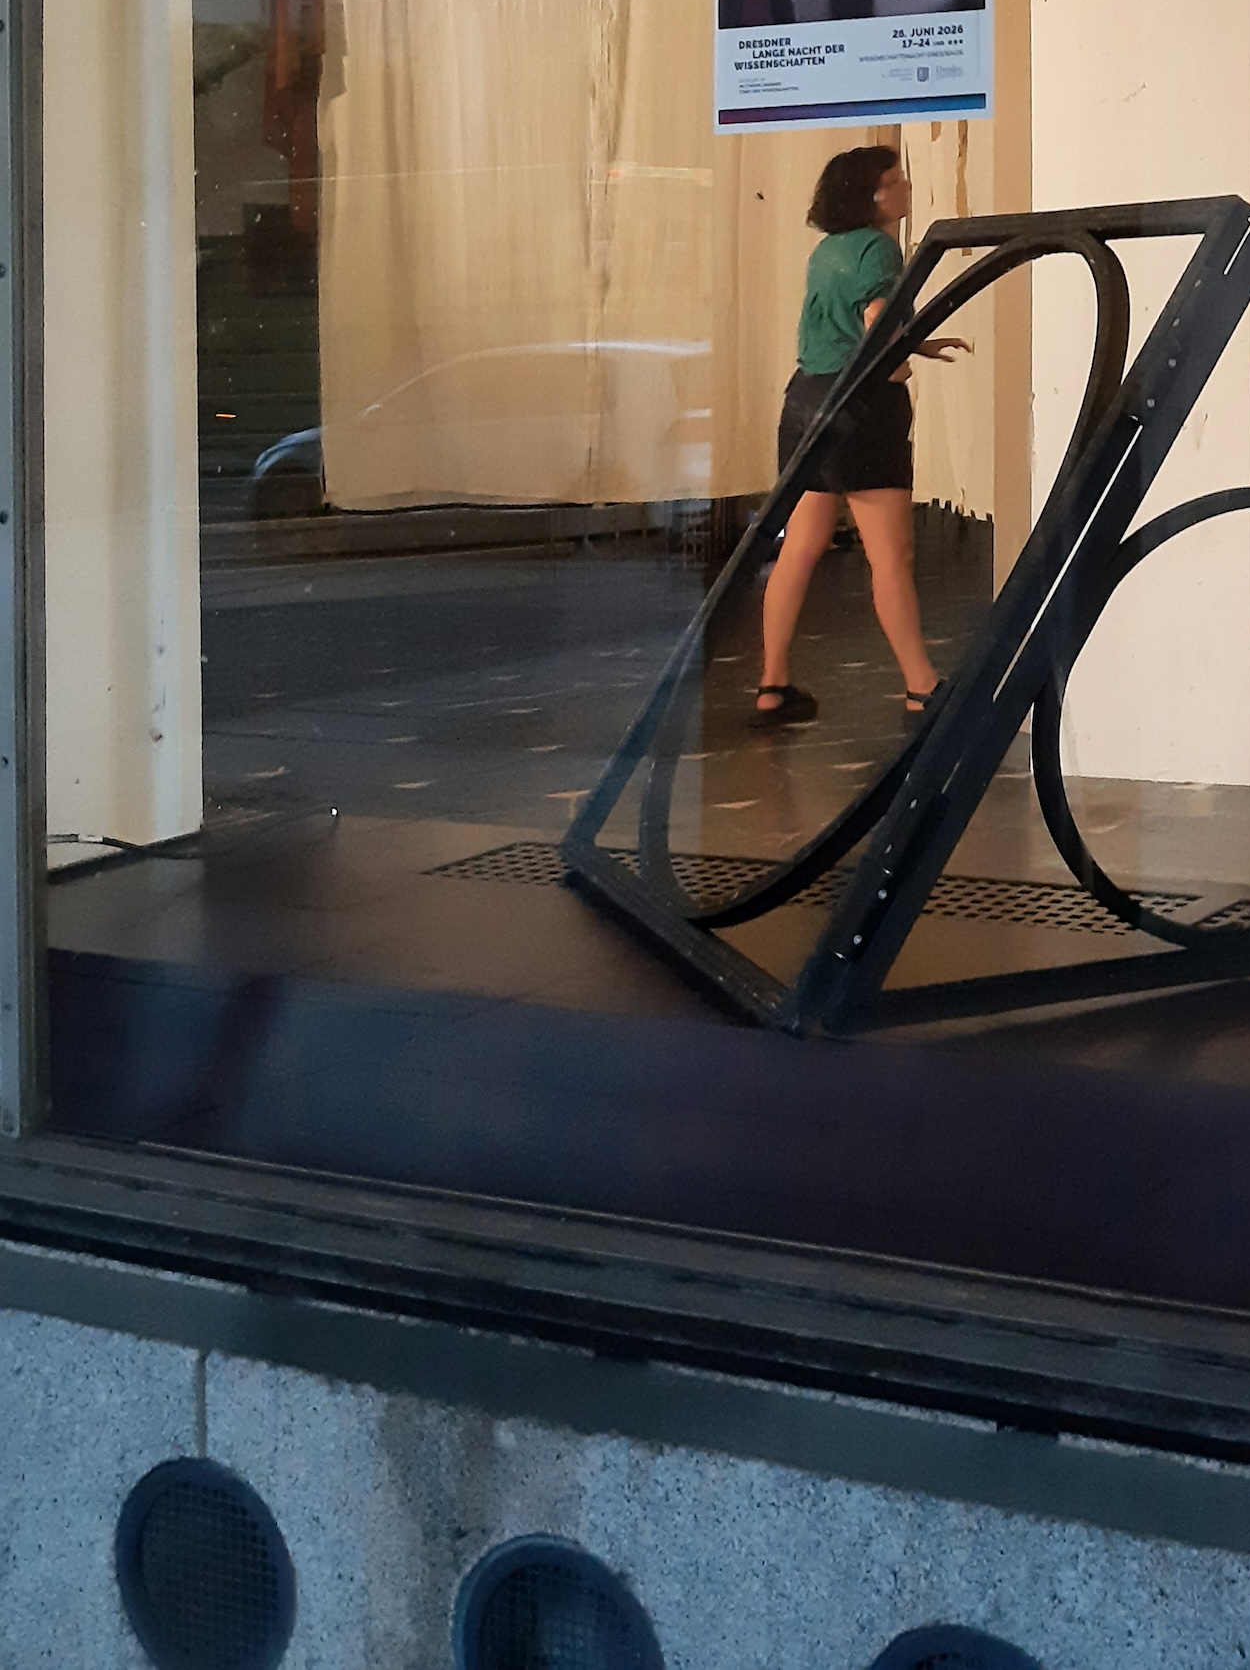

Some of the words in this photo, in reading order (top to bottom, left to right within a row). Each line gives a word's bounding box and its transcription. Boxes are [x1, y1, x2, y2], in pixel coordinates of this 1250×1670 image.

[911, 27, 935, 38] JUNI
[937, 24, 964, 36] 2026
[738, 37, 791, 50] DRESDNER
[752, 48, 786, 59] LANGE
[788, 45, 822, 56] NACHT
[825, 44, 845, 55] DER
[734, 56, 826, 71] WISSENSCHAFTEN
